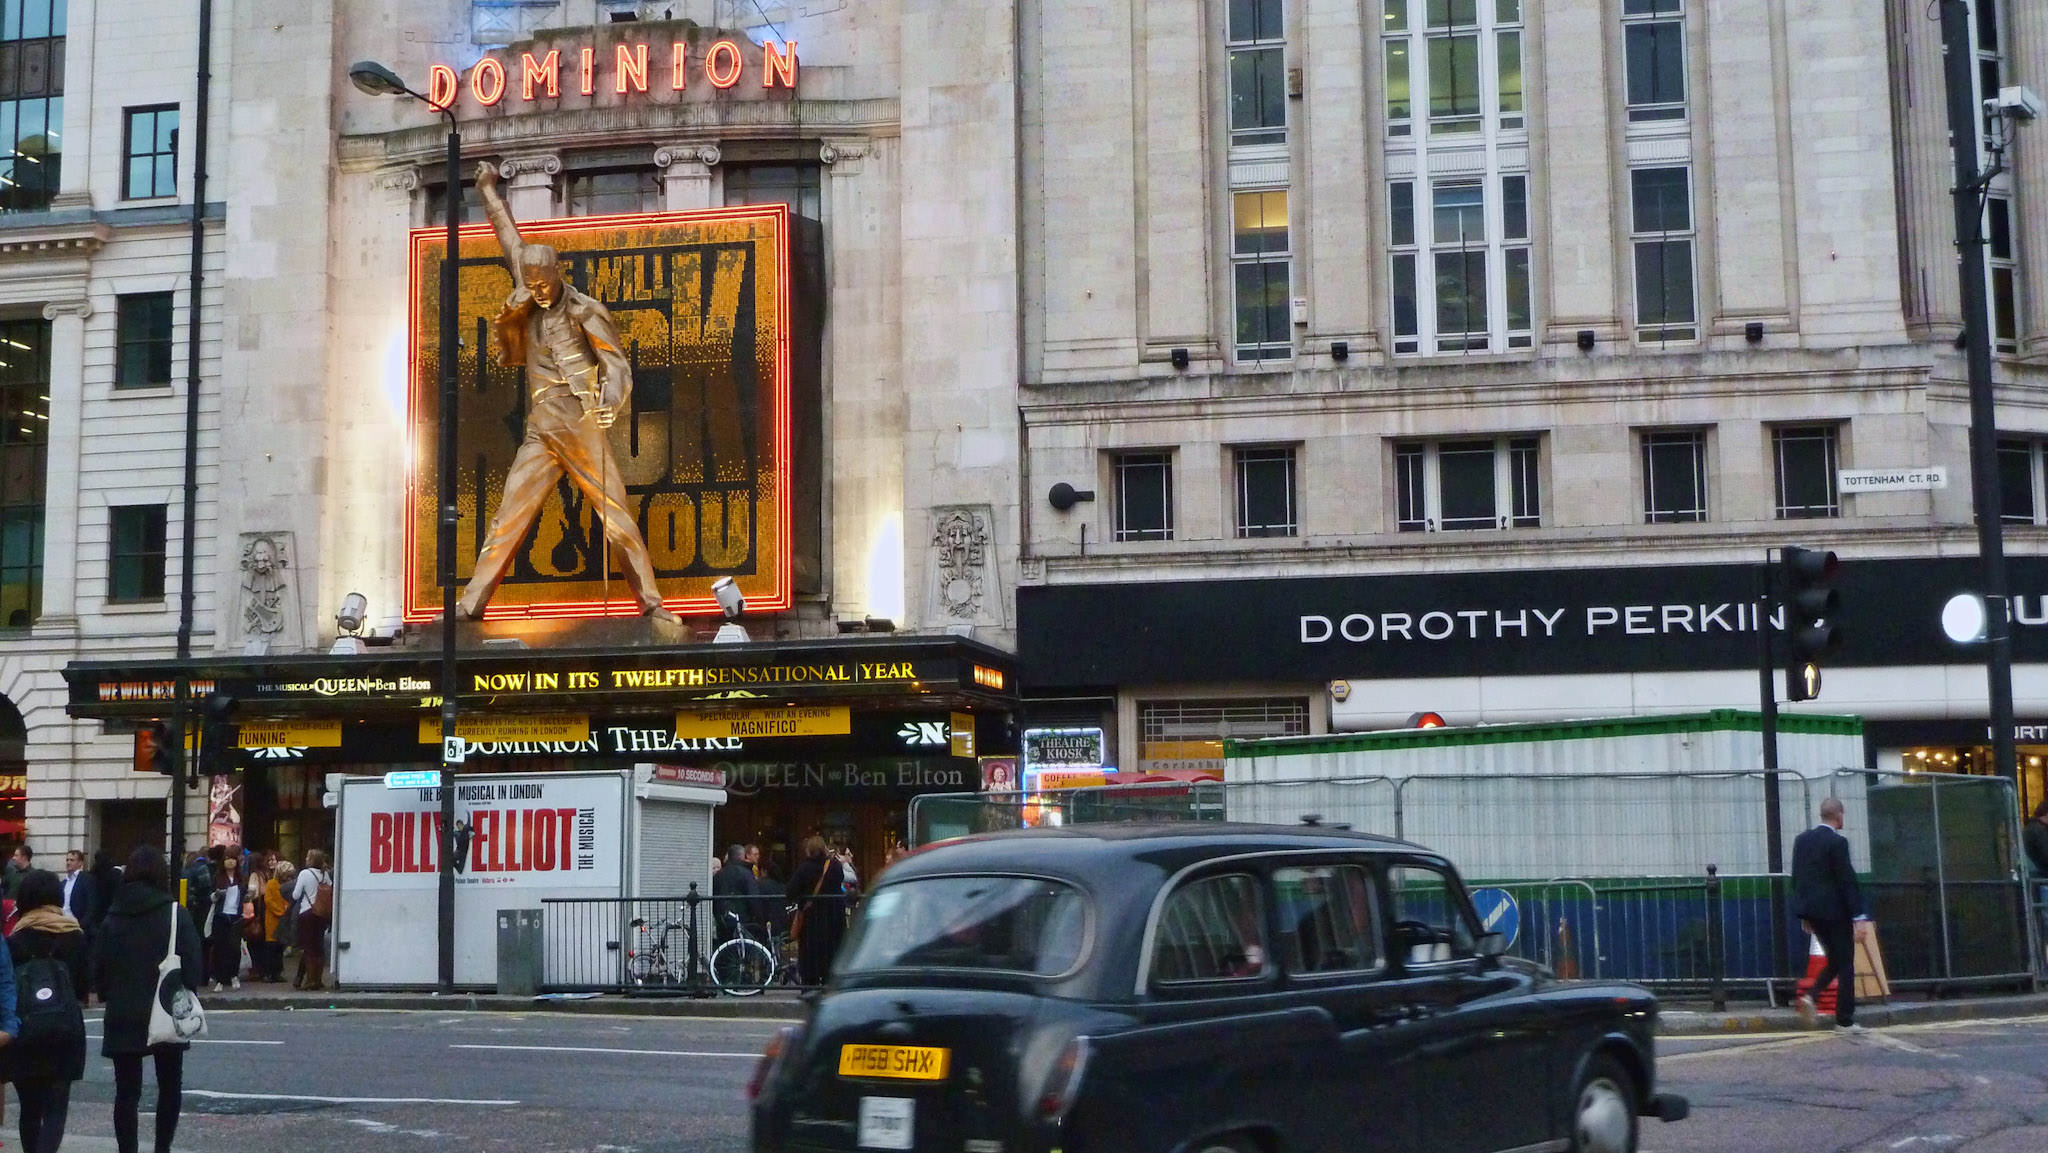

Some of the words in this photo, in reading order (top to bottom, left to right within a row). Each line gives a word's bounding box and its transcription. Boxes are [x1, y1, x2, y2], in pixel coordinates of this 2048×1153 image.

[428, 40, 798, 113] DOMINION
[1844, 475, 1905, 486] TOTTENHAM
[1926, 474, 1940, 483] RD
[1300, 608, 1567, 643] DOROTHY
[1586, 602, 1824, 636] PERKIN
[474, 673, 525, 691] NOW
[535, 672, 559, 690] IN
[568, 671, 600, 689] ITS
[612, 668, 704, 688] TWELFTH
[707, 663, 851, 685] SENSATIONAL
[861, 662, 916, 681] YEAR
[98, 683, 118, 700] WE
[120, 682, 150, 700] WILL
[256, 684, 273, 692] THE
[275, 683, 310, 692] MUSICAL
[314, 677, 368, 696] QUEEN
[375, 679, 397, 691] Ben
[399, 676, 431, 691] Elton
[799, 709, 831, 718] EVENING
[498, 727, 528, 736] RUNNING
[1038, 738, 1091, 749] THEATRE
[1046, 748, 1083, 759] KIOSK
[685, 769, 715, 783] SECONDS
[712, 760, 830, 797] QUEEN
[844, 763, 888, 787] Ben
[897, 761, 963, 786] Elton
[458, 785, 496, 801] MUSICAL
[498, 785, 508, 799] IN
[578, 807, 595, 851] MUSICAL
[471, 808, 577, 872] ELLIOT
[578, 853, 594, 871] THE
[894, 1049, 932, 1073] SHX
